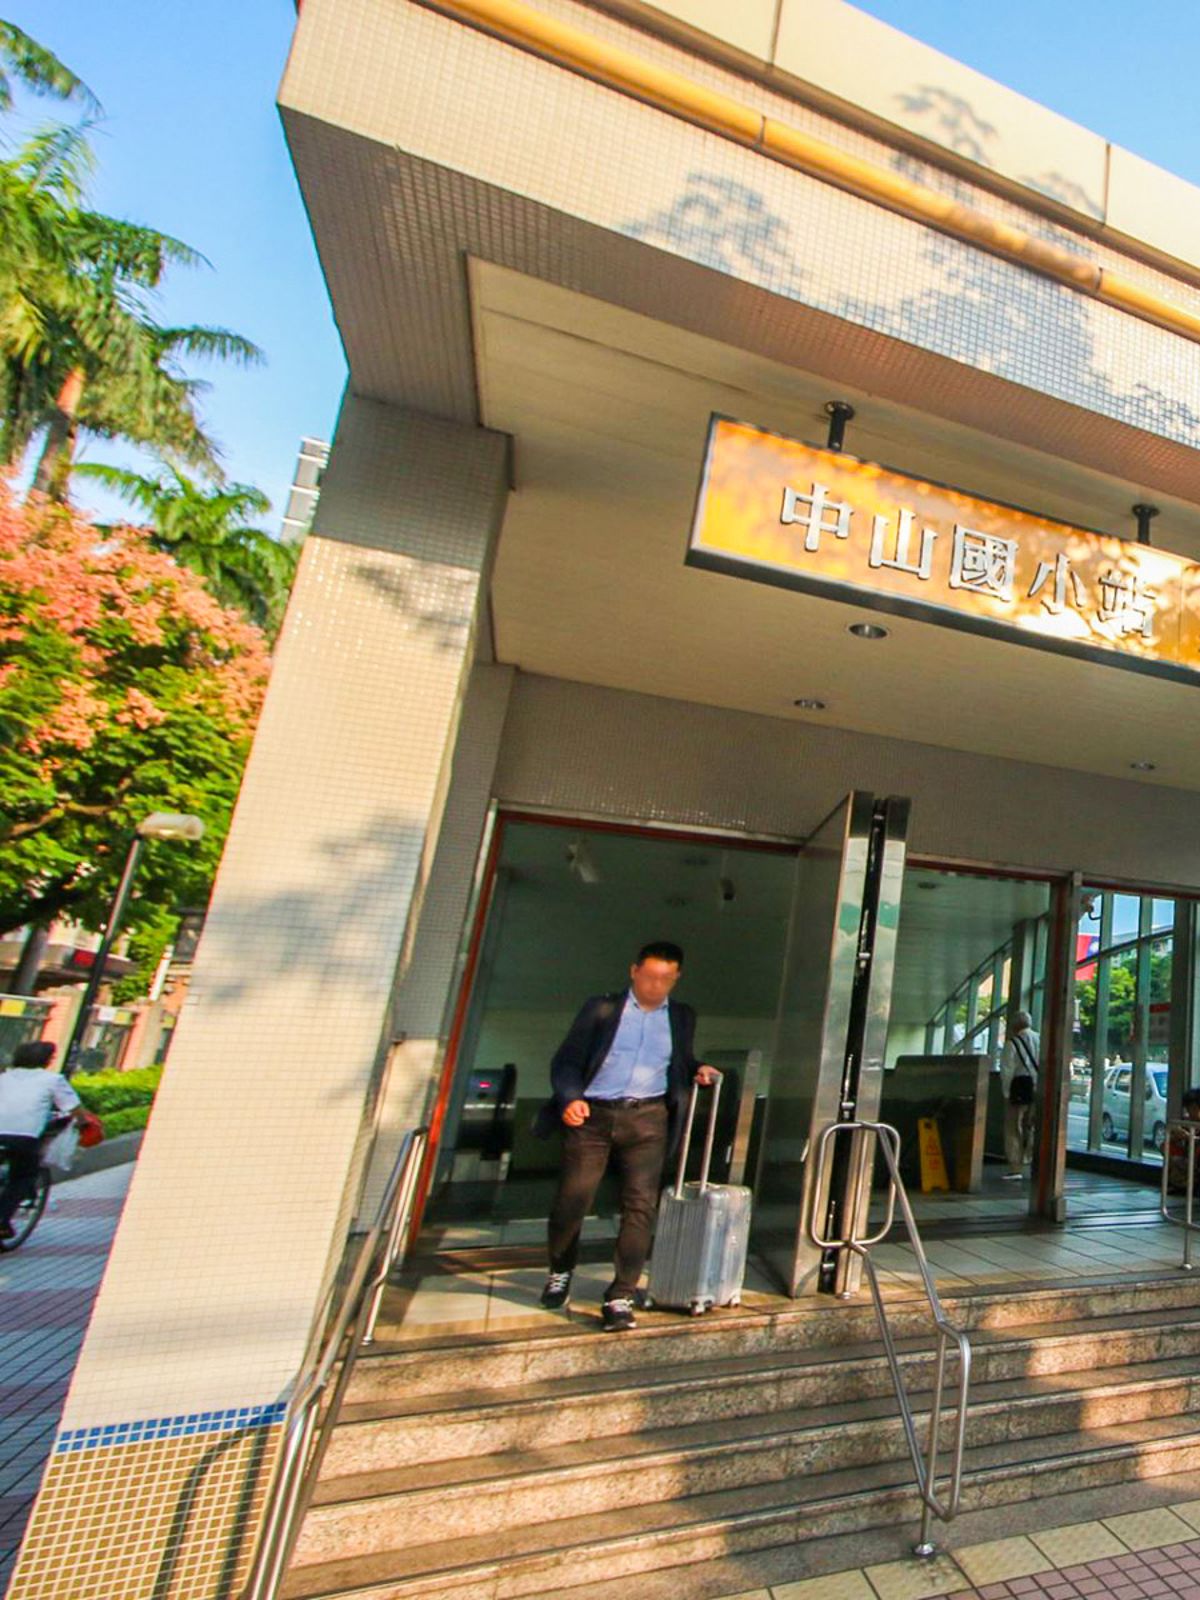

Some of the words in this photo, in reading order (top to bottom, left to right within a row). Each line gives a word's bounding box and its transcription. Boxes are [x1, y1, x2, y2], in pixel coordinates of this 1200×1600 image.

[780, 483, 1156, 638] 中山國小站
